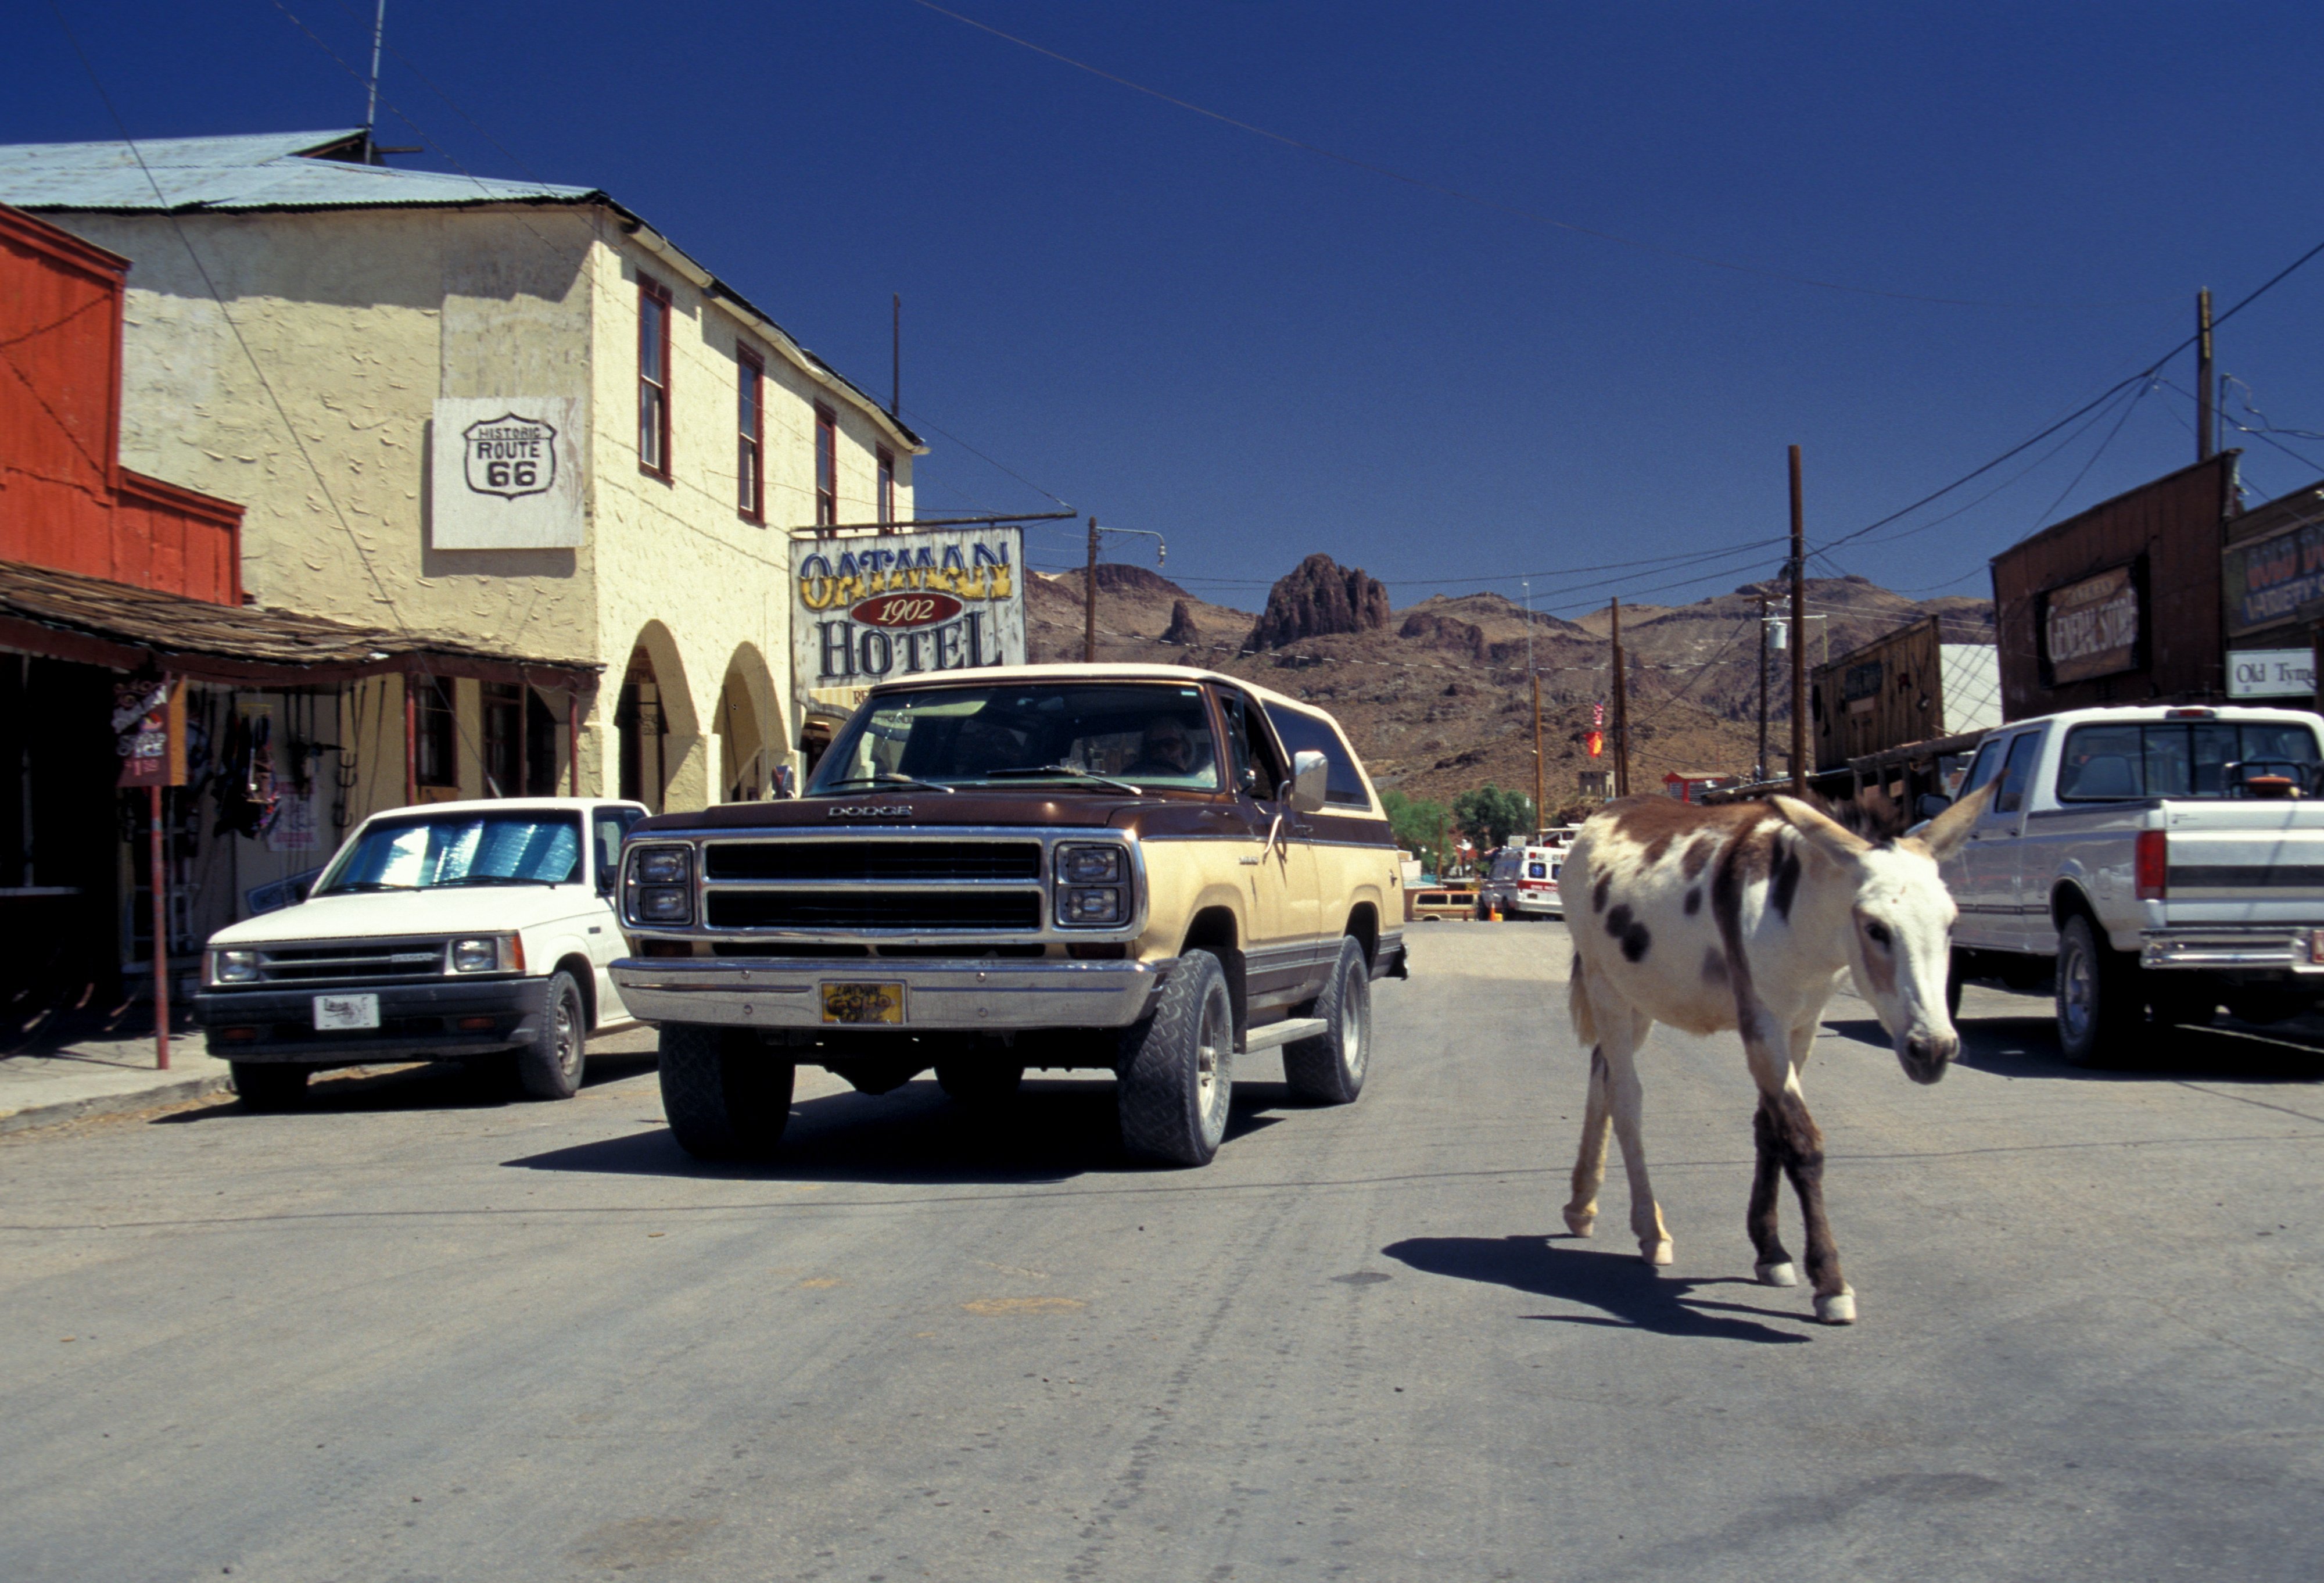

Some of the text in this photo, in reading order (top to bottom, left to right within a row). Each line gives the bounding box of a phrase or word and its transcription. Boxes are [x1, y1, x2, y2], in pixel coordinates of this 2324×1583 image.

[479, 427, 540, 438] HISTORIC
[477, 441, 540, 459] ROUTE
[487, 461, 536, 486] 66
[798, 542, 1012, 612] OATMAN
[877, 599, 935, 625] 1902
[816, 610, 1003, 679] HOTEL
[2236, 663, 2265, 683] Old
[828, 805, 913, 816] DODGE
